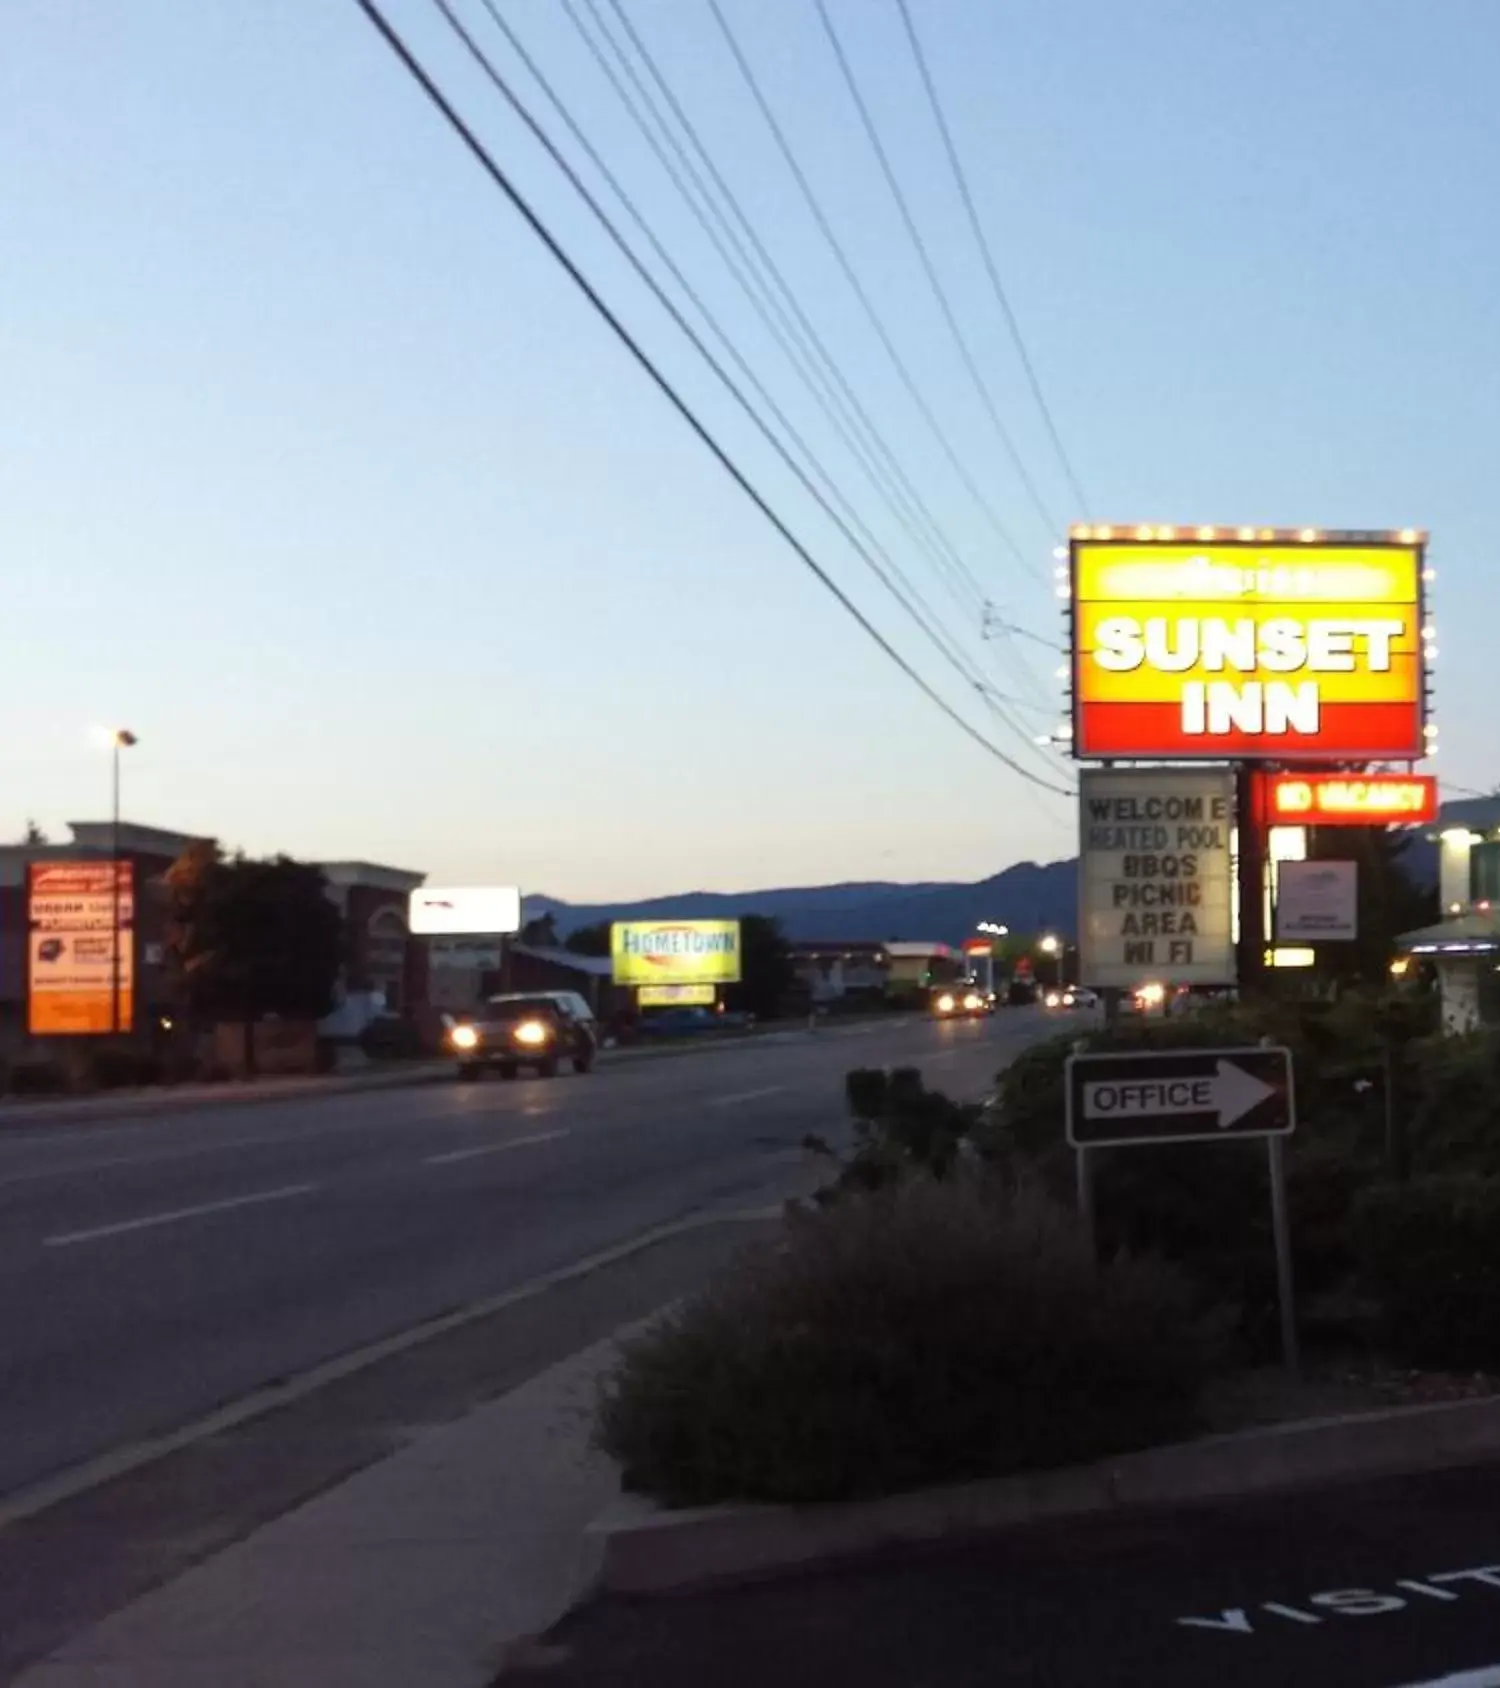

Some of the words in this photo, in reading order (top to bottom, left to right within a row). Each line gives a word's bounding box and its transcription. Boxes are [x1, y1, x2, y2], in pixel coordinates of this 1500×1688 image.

[1092, 615, 1406, 673] SUNSET
[1181, 680, 1321, 735] INN
[1088, 796, 1226, 820] WELCOME
[1317, 782, 1425, 812] VACANCY
[1088, 825, 1169, 851] HEATED
[1177, 825, 1225, 850] POOL
[1122, 854, 1198, 879] BBQS
[1112, 882, 1202, 908] PICNIC
[1121, 911, 1198, 937] AREA
[623, 929, 736, 954] HOMETOWN
[1093, 1081, 1212, 1111] OFFICE
